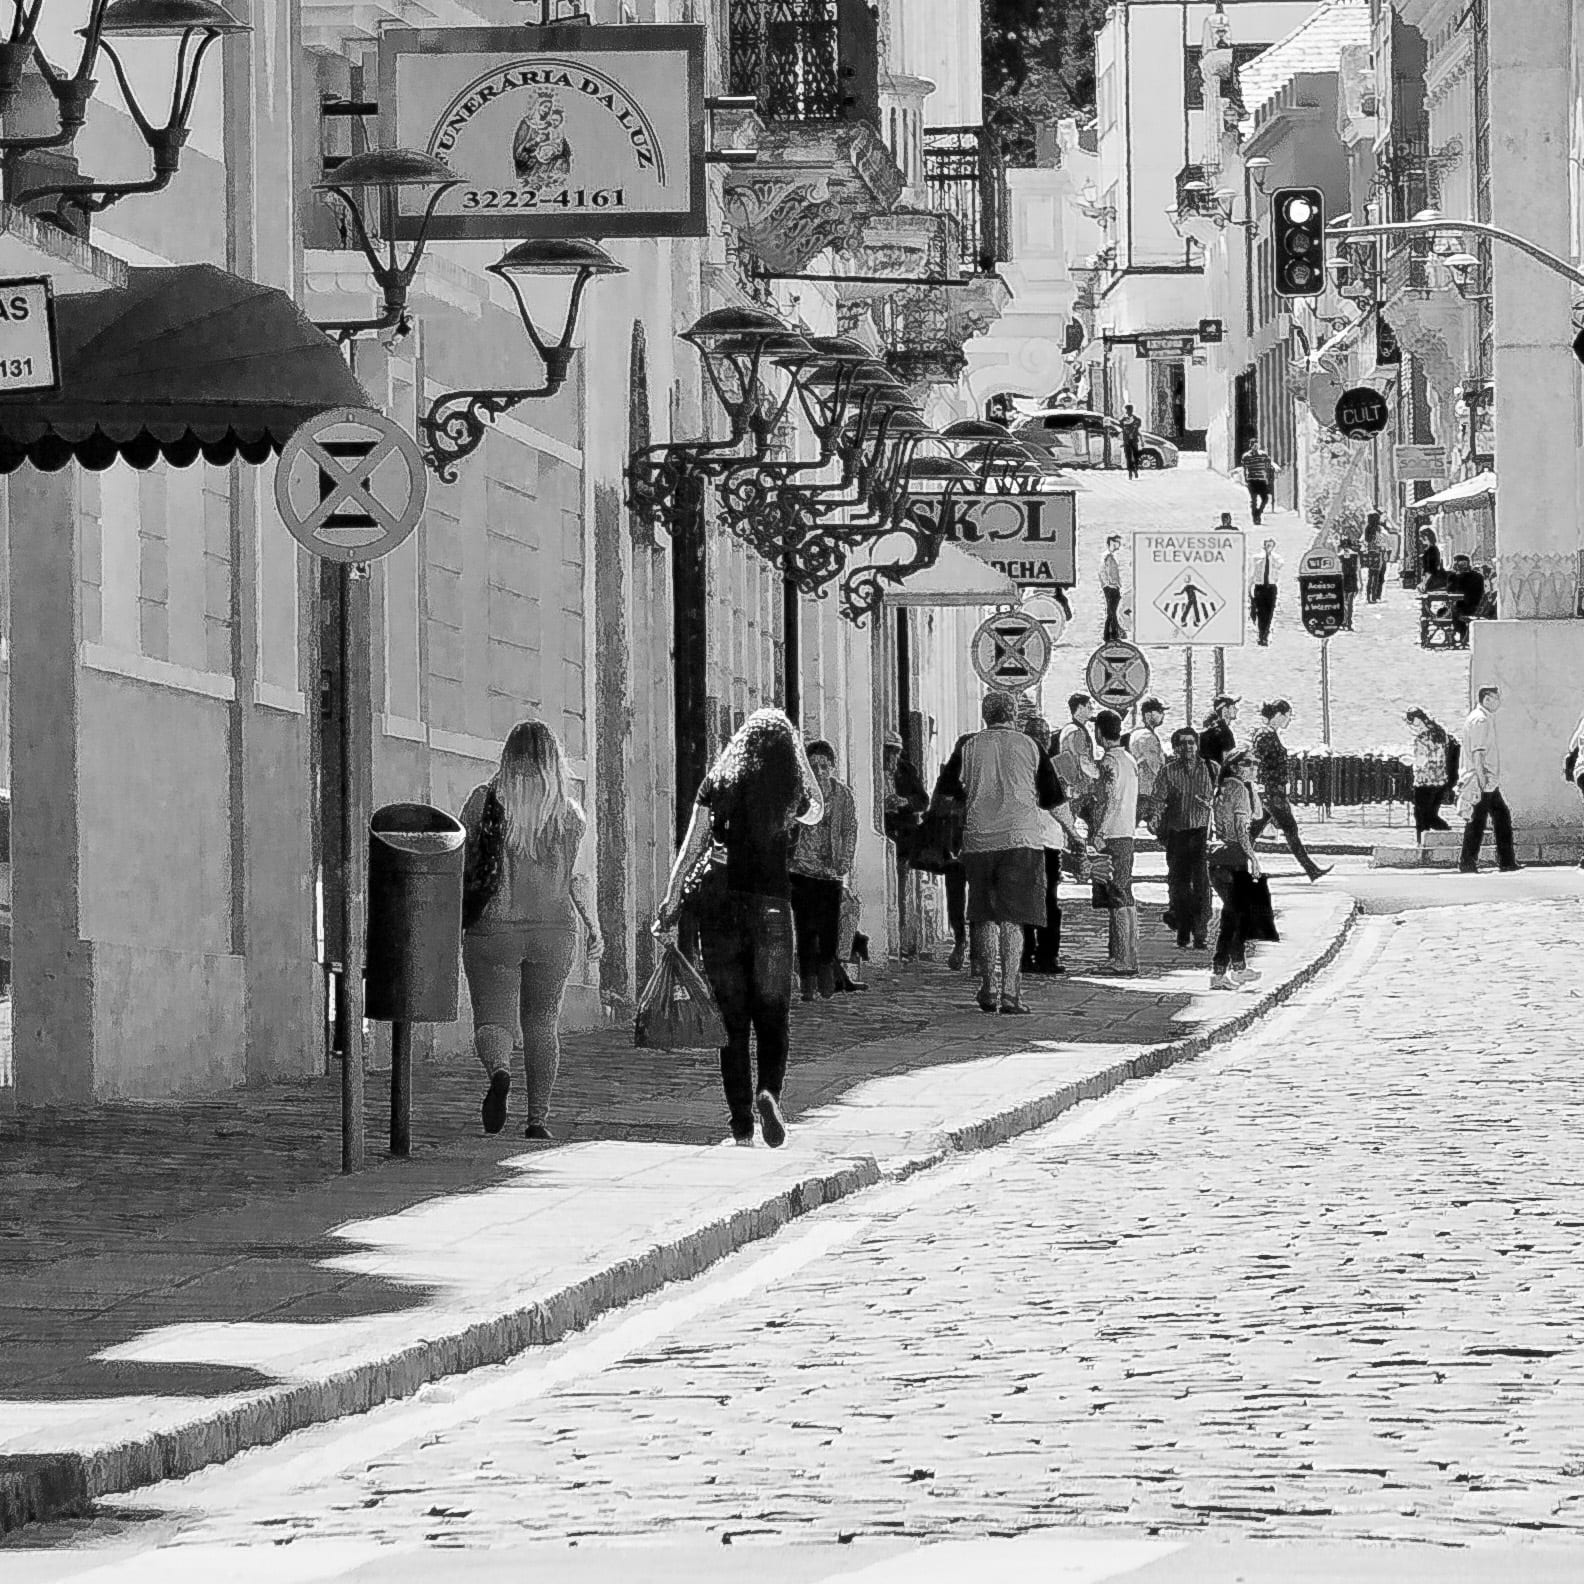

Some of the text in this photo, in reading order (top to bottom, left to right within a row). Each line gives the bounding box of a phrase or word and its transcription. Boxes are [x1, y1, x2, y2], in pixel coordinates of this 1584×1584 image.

[579, 77, 617, 112] DA
[617, 107, 656, 170] LUZ
[462, 188, 628, 209] 3222-4161
[1343, 404, 1382, 425] CULT
[1145, 536, 1233, 549] TRAVESSIA
[1152, 550, 1225, 563] ELEVADA
